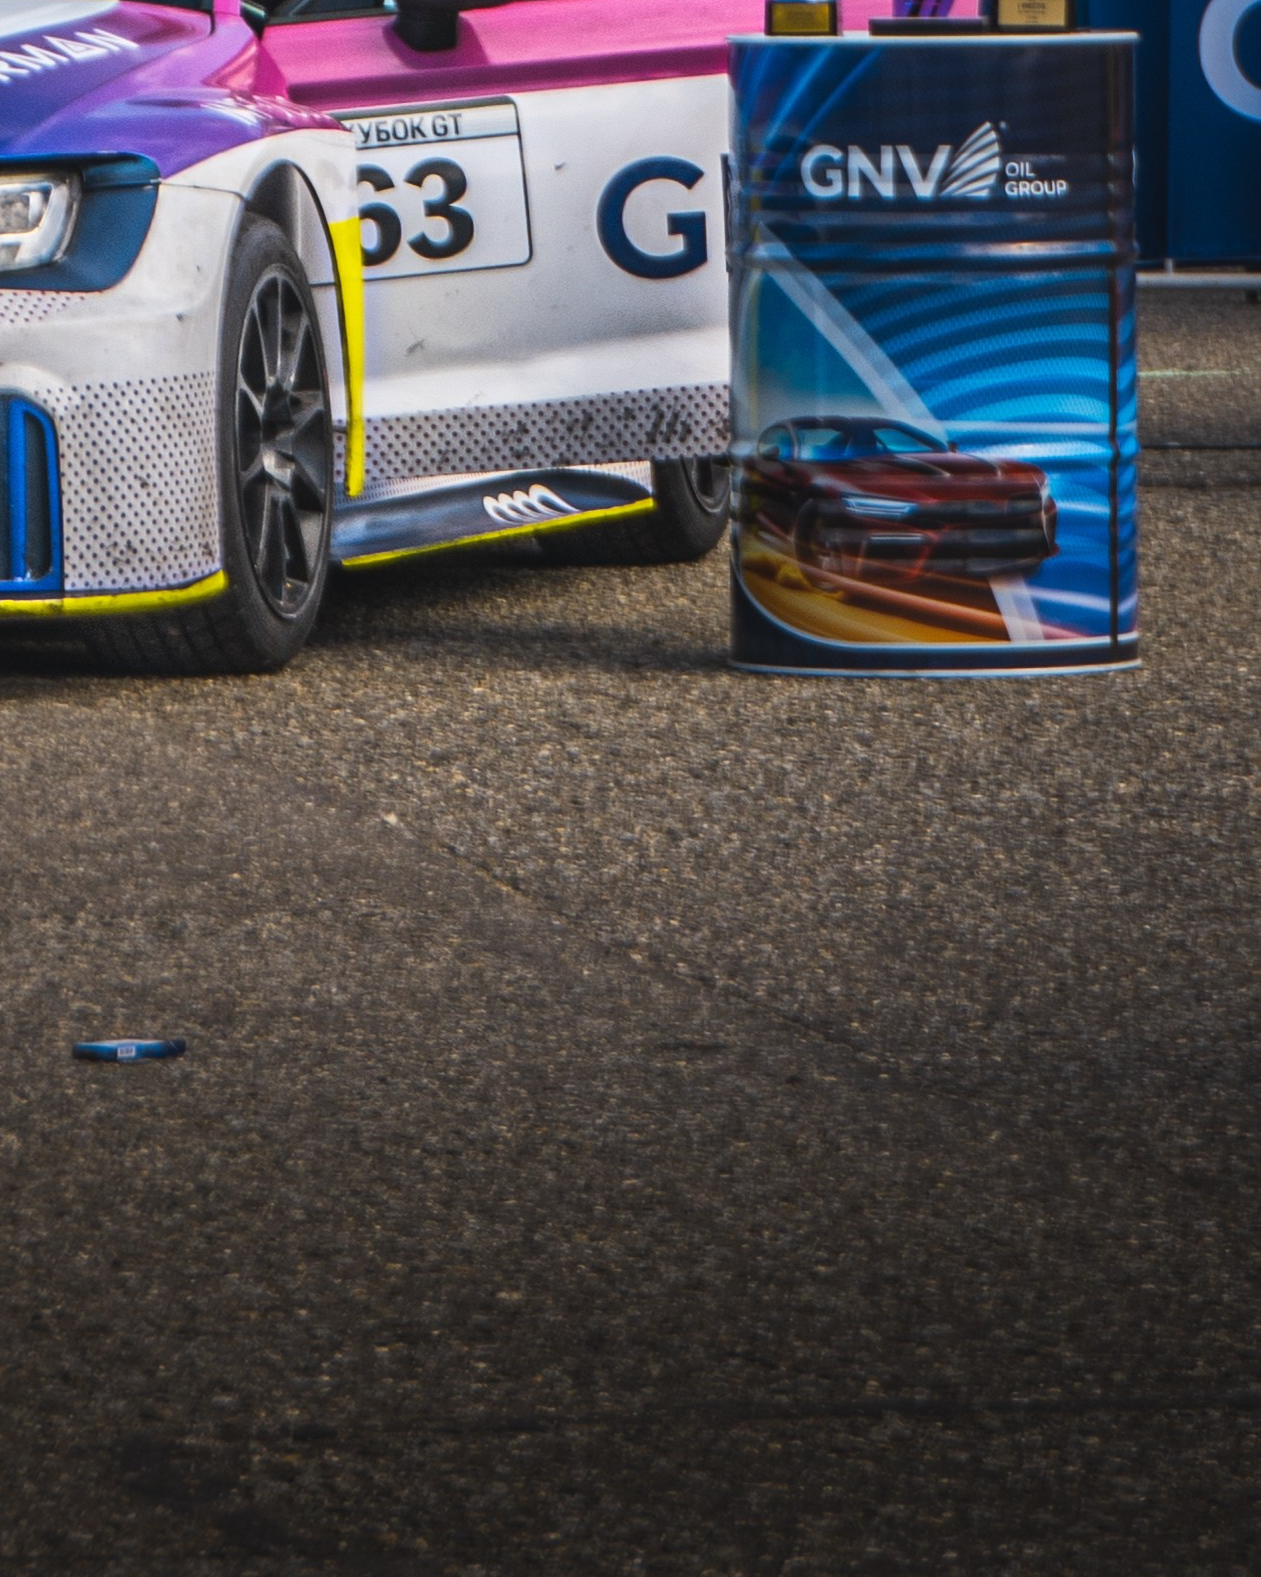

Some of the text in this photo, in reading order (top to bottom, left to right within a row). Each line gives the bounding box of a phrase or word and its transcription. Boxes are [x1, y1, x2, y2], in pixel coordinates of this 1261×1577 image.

[347, 113, 462, 144] УБОК GT
[800, 144, 1035, 197] GNV OIL
[1004, 180, 1068, 197] GROUP
[356, 156, 475, 267] 63
